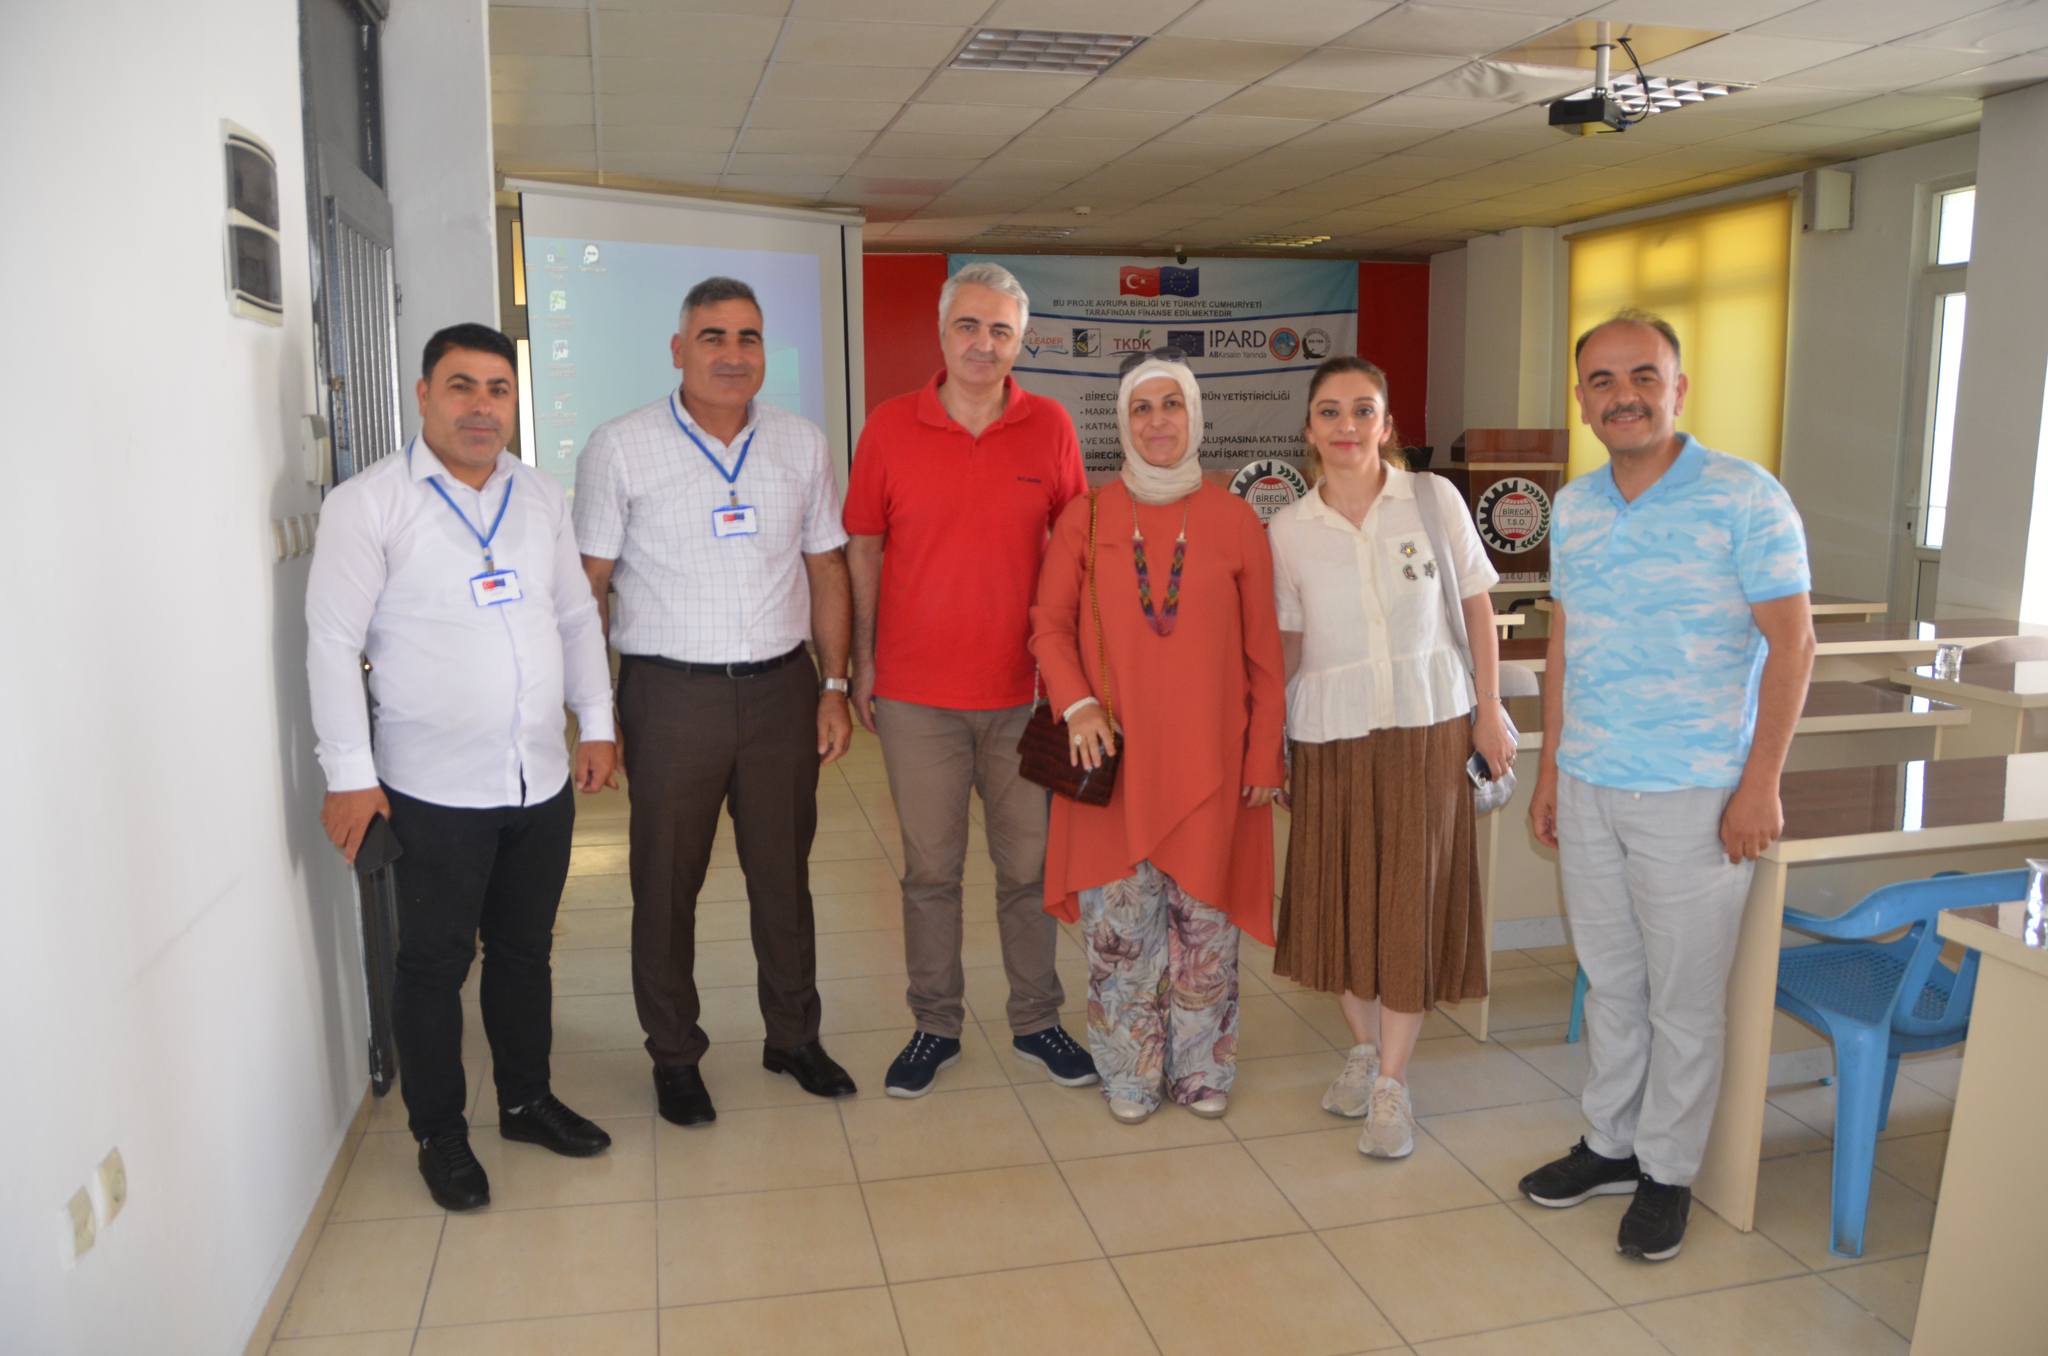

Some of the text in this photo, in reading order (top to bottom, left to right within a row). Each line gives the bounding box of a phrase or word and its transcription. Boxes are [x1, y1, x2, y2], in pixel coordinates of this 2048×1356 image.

[1053, 299, 1065, 307] BU
[1067, 299, 1095, 307] PROJE
[1096, 300, 1128, 308] AVRUPA
[1130, 299, 1158, 308] BİRLİĞİ
[1173, 299, 1207, 308] TÜRKİYE
[1209, 300, 1263, 309] CUMHURİYETİ
[1085, 308, 1233, 317] TARAFINDAN FİNANSE EDİLMEKTEDİR
[1028, 336, 1064, 345] LEADER
[1113, 338, 1151, 350] TKDK
[1209, 330, 1267, 348] IPARD
[1223, 390, 1291, 402] YETİŞTİRİCİLİĞİ
[1085, 423, 1118, 431] KATMA
[1085, 437, 1097, 445] VE
[1259, 435, 1287, 444] KATKI
[1085, 449, 1122, 459] BİRECİK
[1199, 448, 1222, 459] RAFİ
[1223, 448, 1255, 459] İŞARET
[1256, 449, 1291, 458] OLMASI
[1293, 448, 1306, 457] İLE
[1255, 493, 1289, 503] BİRECİK
[1502, 508, 1532, 516] BİRECİK
[1507, 518, 1527, 526] T.S.O.
